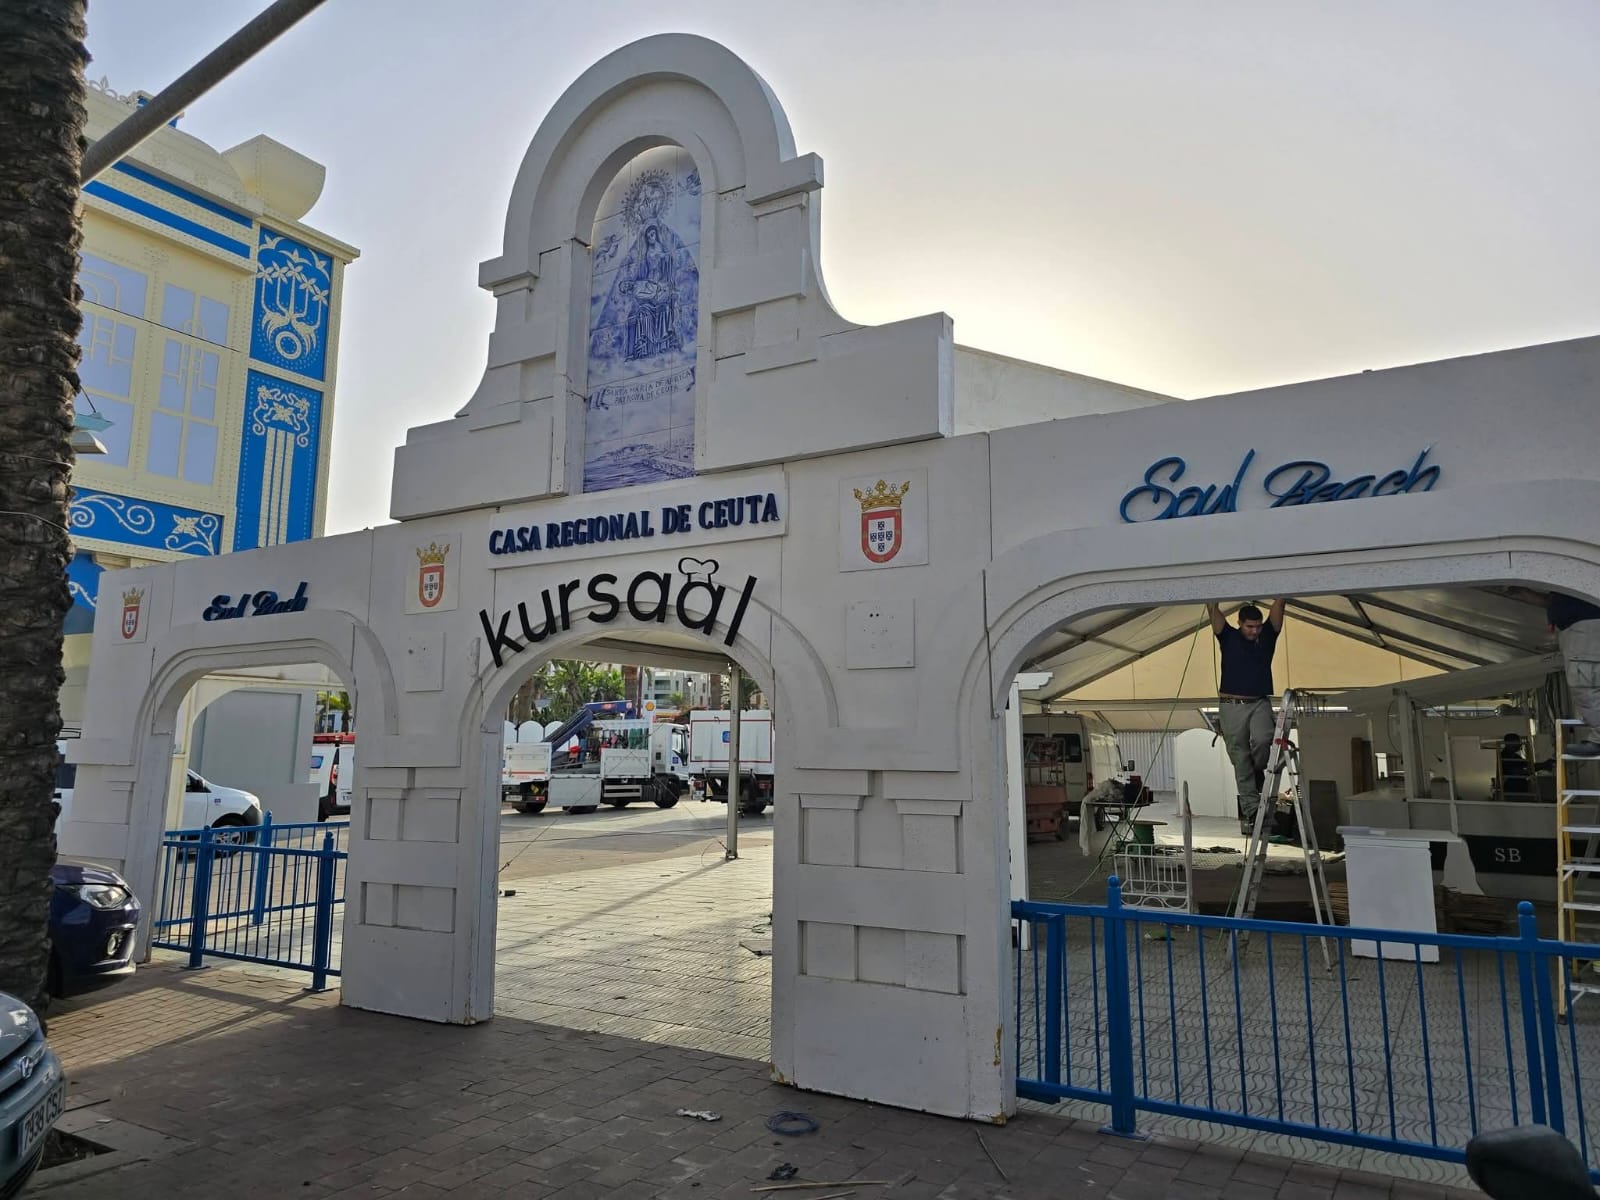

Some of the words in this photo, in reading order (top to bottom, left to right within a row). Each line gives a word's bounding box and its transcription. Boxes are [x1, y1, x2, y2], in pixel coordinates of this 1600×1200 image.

[1119, 448, 1255, 523] Soul
[1263, 442, 1441, 509] Beach
[489, 525, 542, 555] CASA
[546, 510, 654, 549] REGIONAL
[661, 504, 692, 535] DE
[699, 493, 780, 530] CEUTA
[479, 560, 758, 668] kursaal
[1494, 847, 1521, 863] SB
